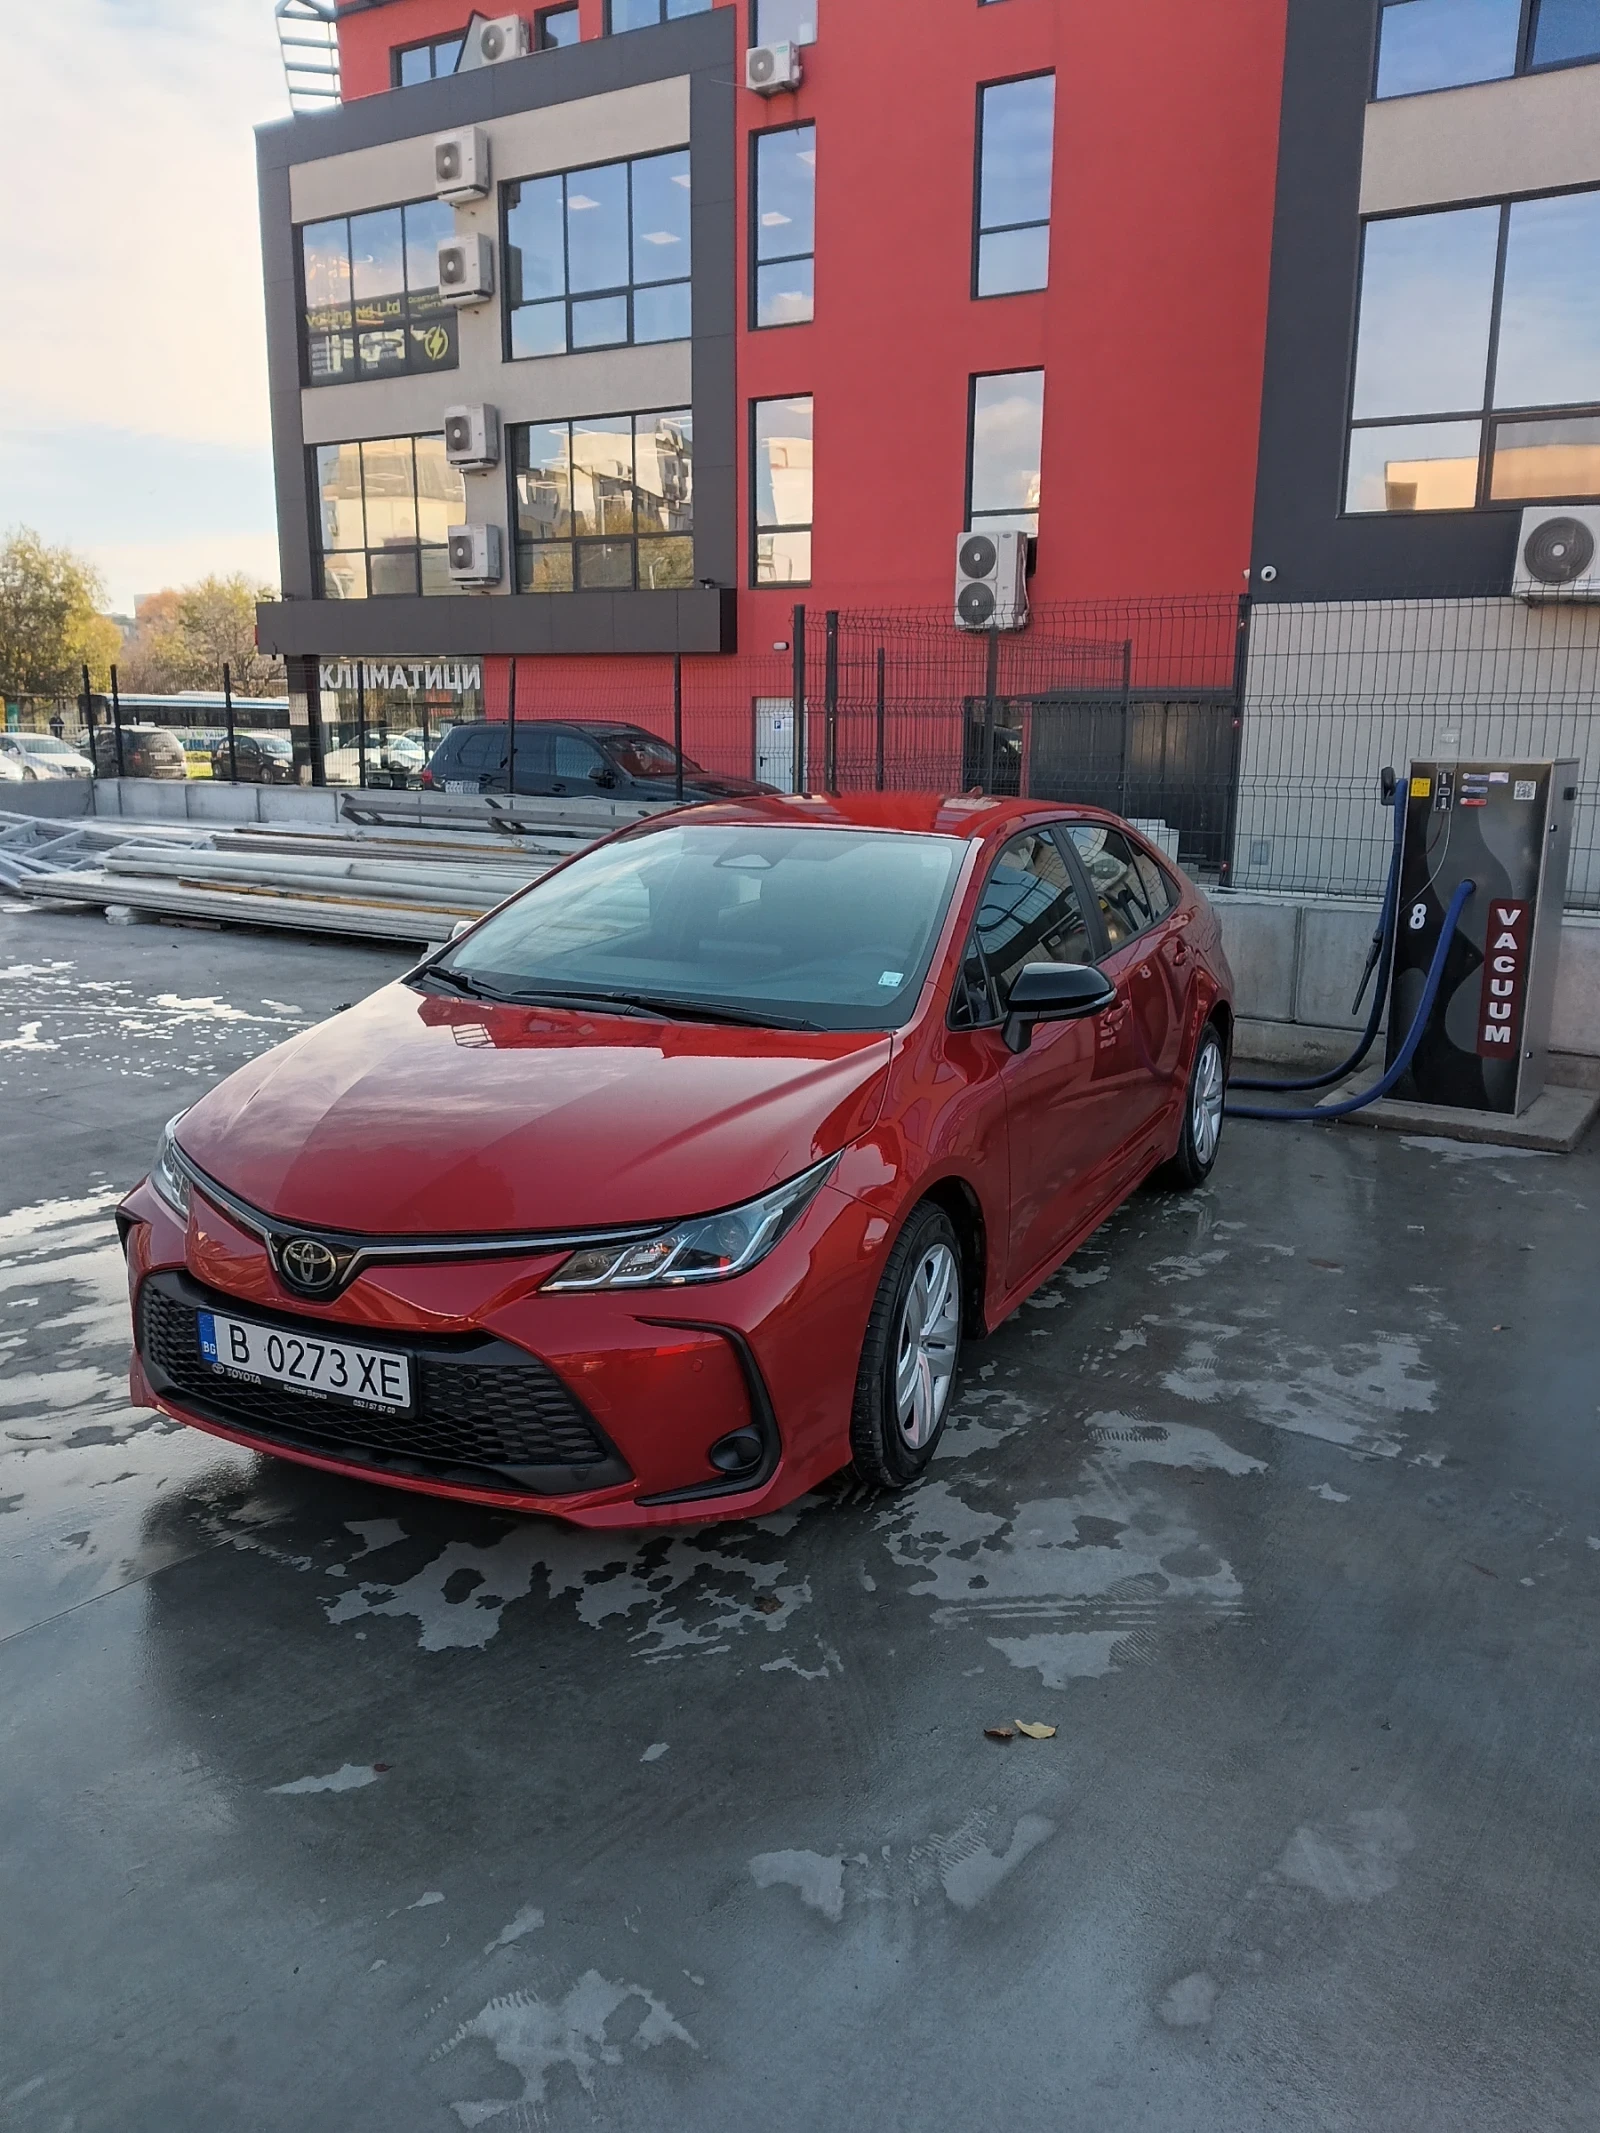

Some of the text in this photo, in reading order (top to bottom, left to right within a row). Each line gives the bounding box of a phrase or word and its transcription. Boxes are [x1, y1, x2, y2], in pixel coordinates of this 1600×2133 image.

[319, 664, 481, 694] КЛИМАТИЦИ
[1409, 903, 1427, 930] 8
[1484, 908, 1522, 1043] VACUUM
[203, 1341, 216, 1355] BG
[226, 1367, 262, 1385] TOYOTA
[229, 1324, 403, 1401] B 0273 XE
